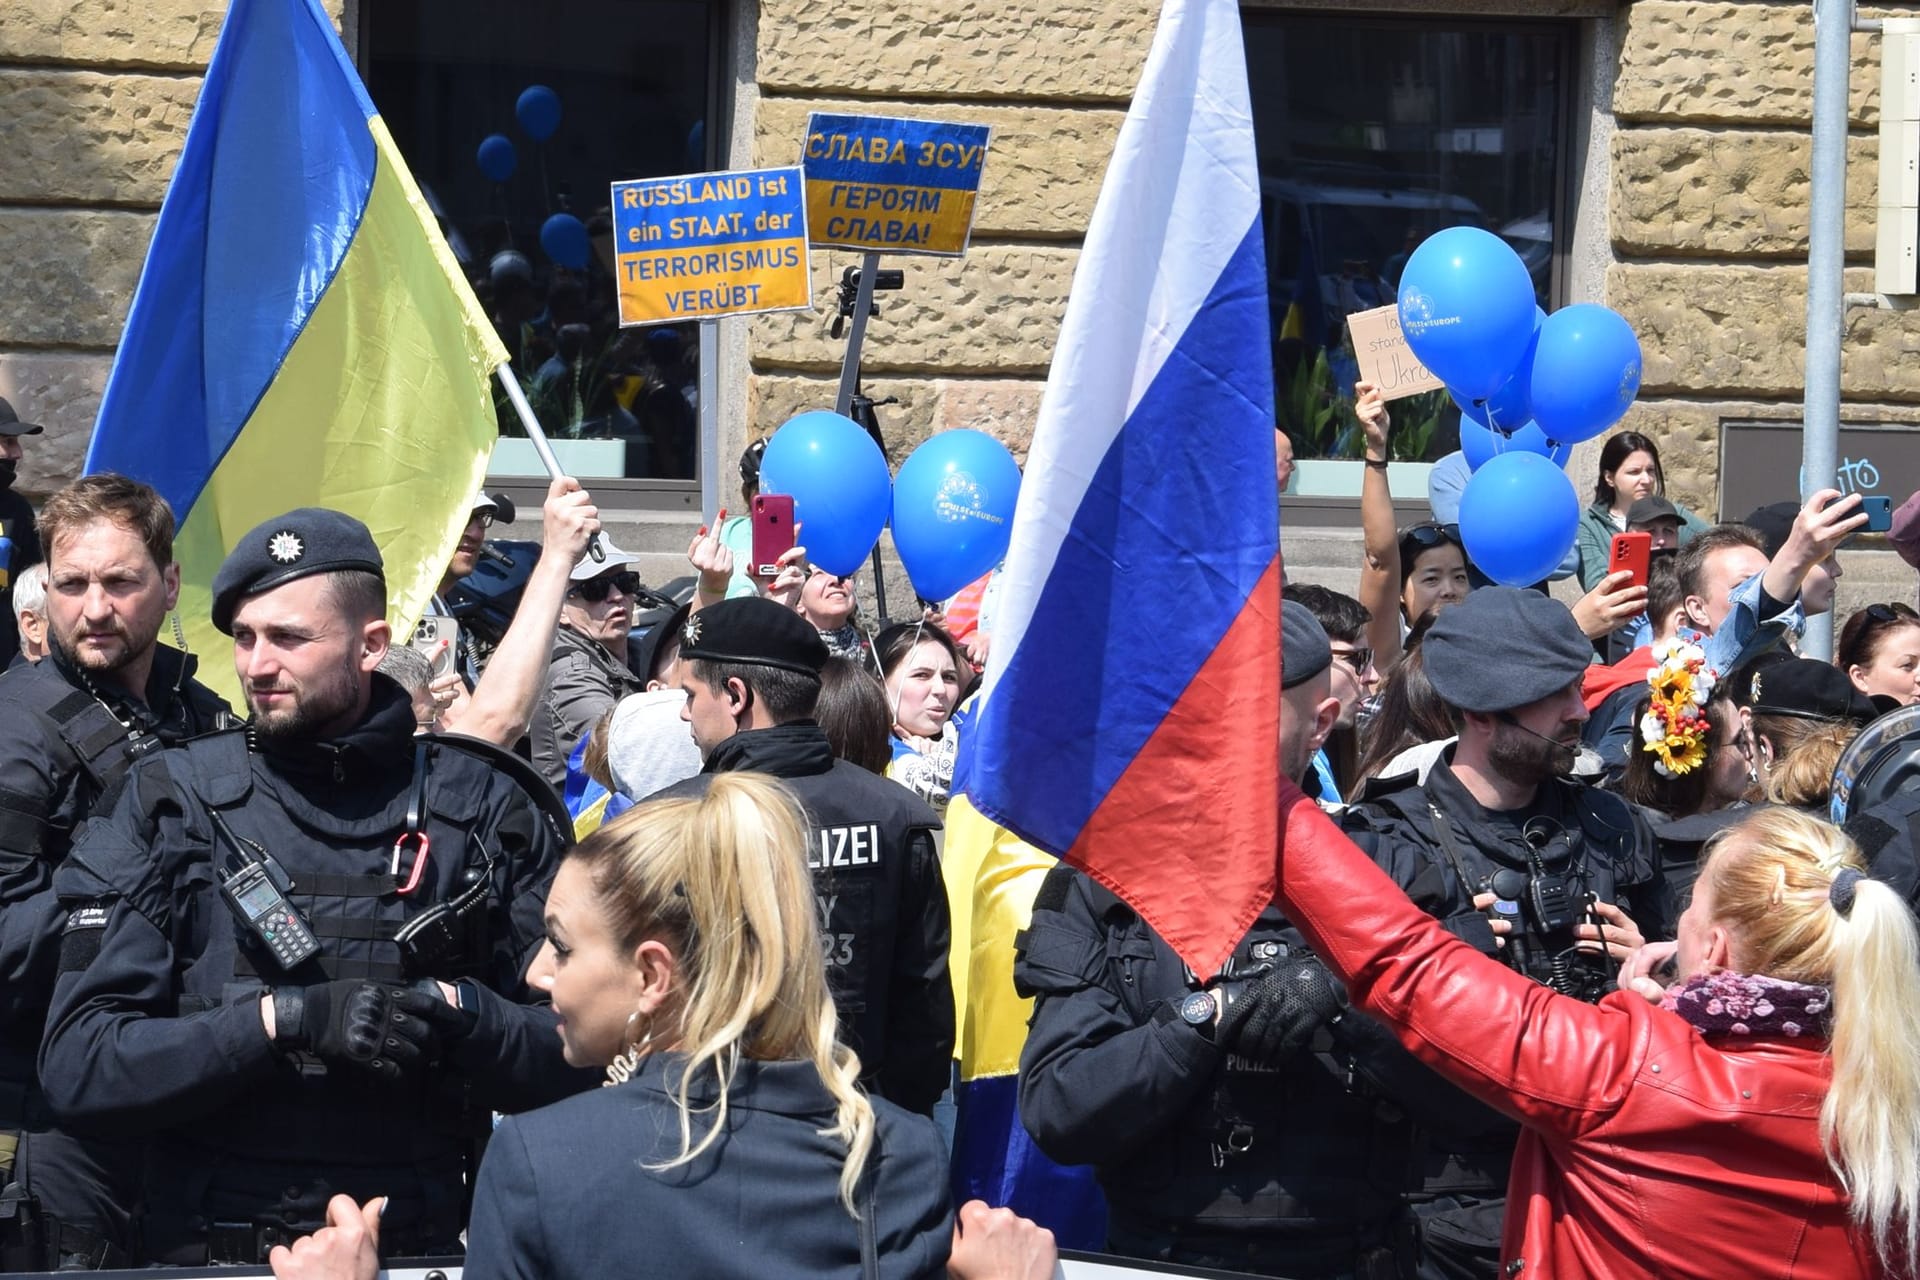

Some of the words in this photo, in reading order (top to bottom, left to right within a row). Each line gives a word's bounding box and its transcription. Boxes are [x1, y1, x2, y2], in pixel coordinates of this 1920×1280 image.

[806, 133, 906, 165] СЛАВА
[917, 141, 985, 171] ЗСУ!
[623, 177, 751, 209] RUSSLAND
[759, 176, 787, 197] ist
[830, 185, 941, 214] ГЕРОЯМ
[628, 221, 662, 242] ein
[670, 212, 747, 239] STAAT,
[755, 210, 793, 231] der
[827, 217, 931, 244] СЛАВА!
[624, 246, 799, 282] TERRORISMUS
[666, 282, 761, 313] VERÜBT
[1380, 310, 1399, 330] Ta
[1377, 353, 1433, 390] Ukra
[803, 825, 879, 868] LIZEI
[821, 932, 856, 966] 23
